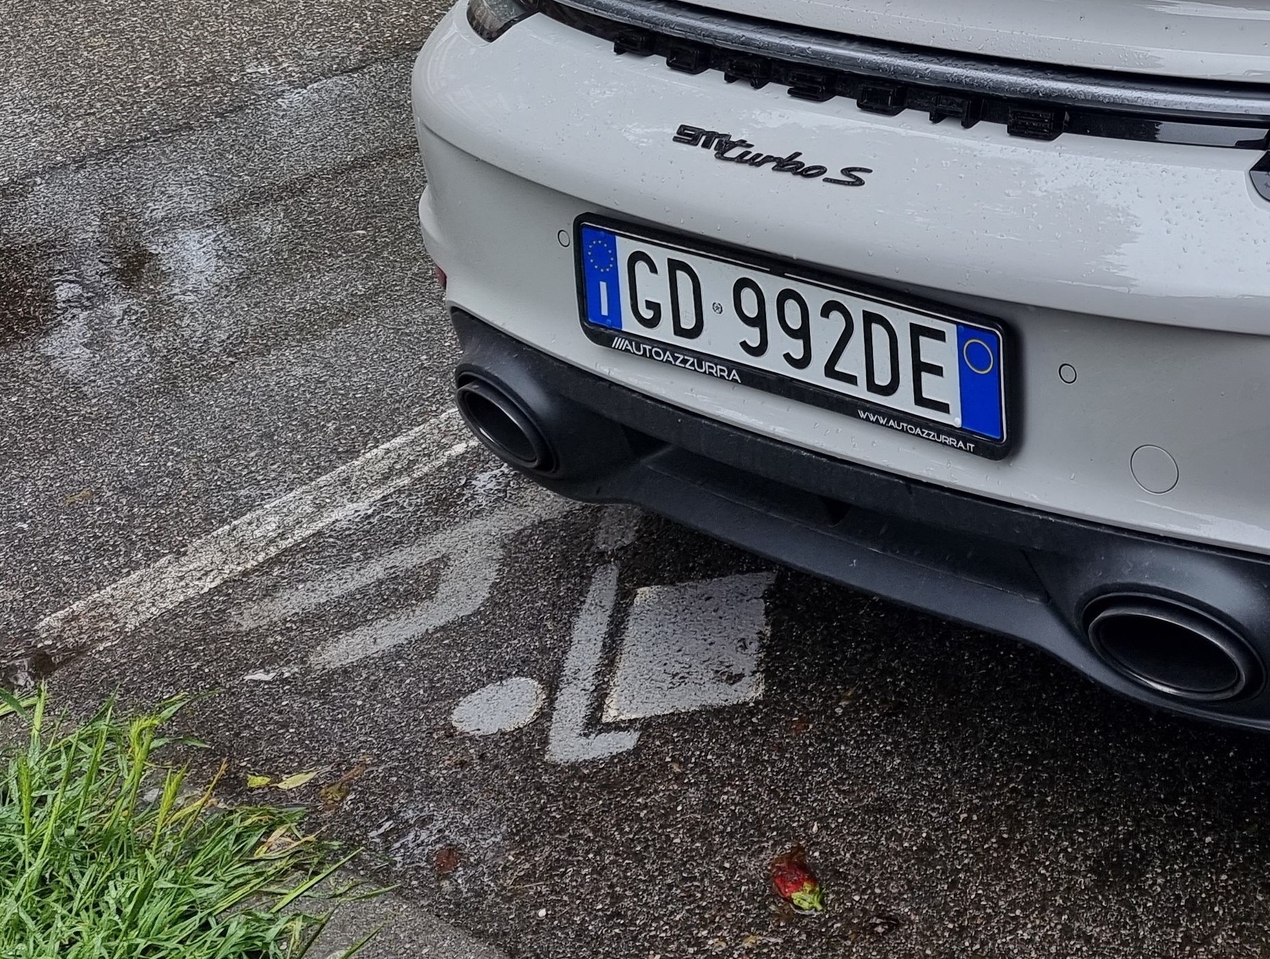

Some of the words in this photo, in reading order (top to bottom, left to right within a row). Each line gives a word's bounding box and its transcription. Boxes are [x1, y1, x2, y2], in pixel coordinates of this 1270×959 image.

[822, 166, 873, 187] S
[627, 250, 704, 340] GD
[732, 276, 950, 415] 992DE
[857, 409, 976, 453] WWW.AUTOAZZURRA.IT
